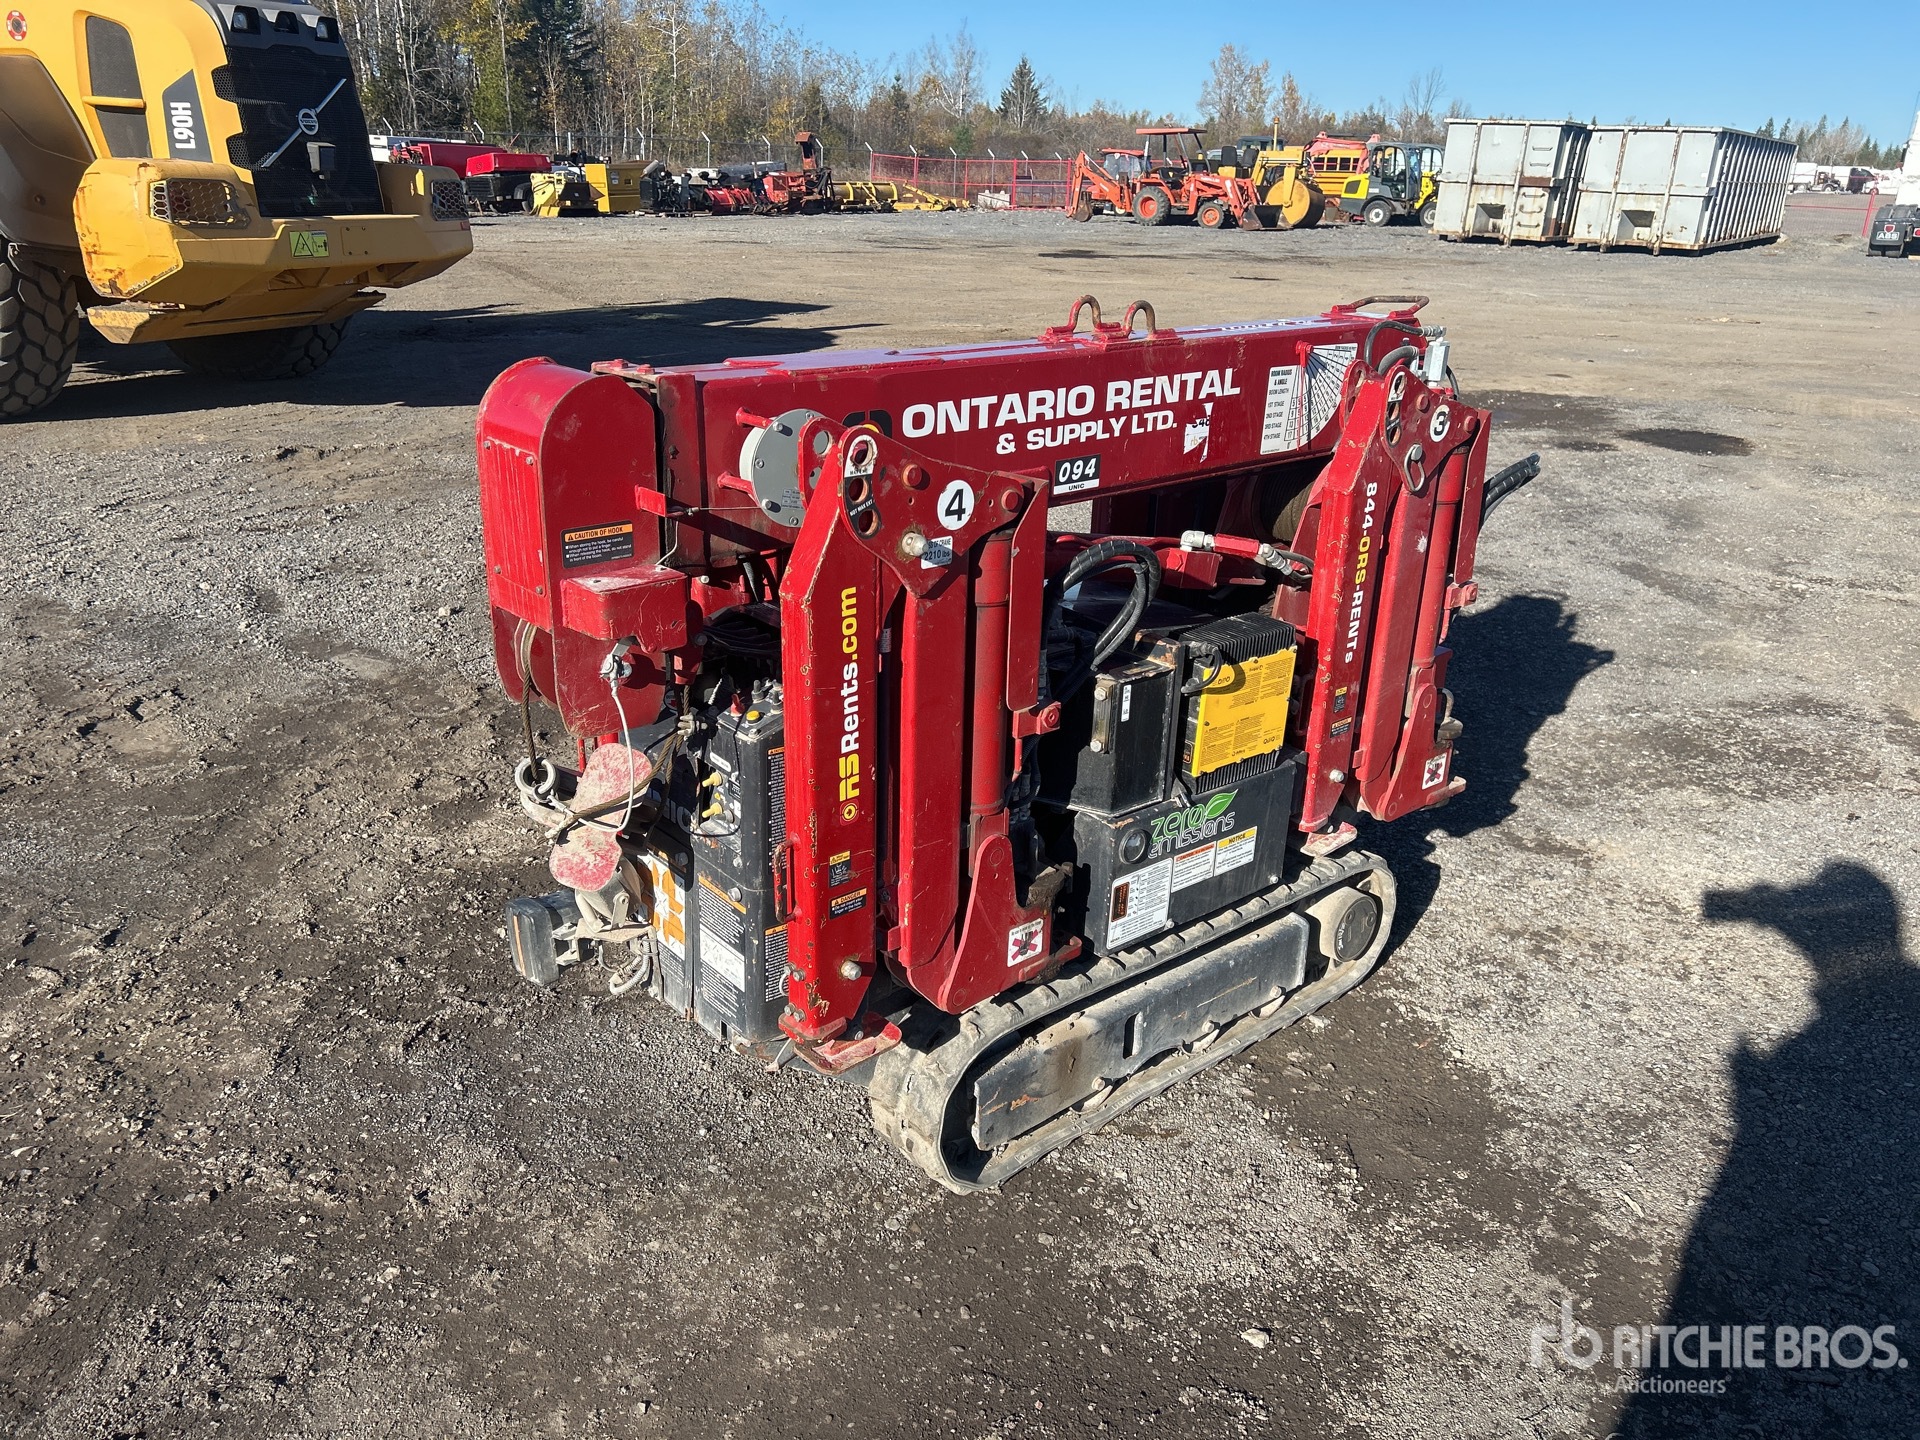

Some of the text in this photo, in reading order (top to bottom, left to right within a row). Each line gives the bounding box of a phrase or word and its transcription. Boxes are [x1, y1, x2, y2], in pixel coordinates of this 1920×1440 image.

[170, 102, 196, 149] L90H
[902, 368, 1241, 438] ONTARIO RENTAL
[996, 410, 1178, 455] & SUPPLY LTD.
[1433, 411, 1447, 436] 3
[1058, 458, 1097, 483] 094
[1068, 483, 1085, 491] UNIC
[945, 488, 966, 521] 4
[574, 531, 599, 540] CAUTION
[607, 526, 624, 534] HOOK
[924, 550, 941, 560] 2210
[1148, 811, 1236, 859] emissions
[1151, 803, 1206, 843] zero
[1228, 832, 1247, 845] NOTICE
[840, 891, 861, 903] DANGER
